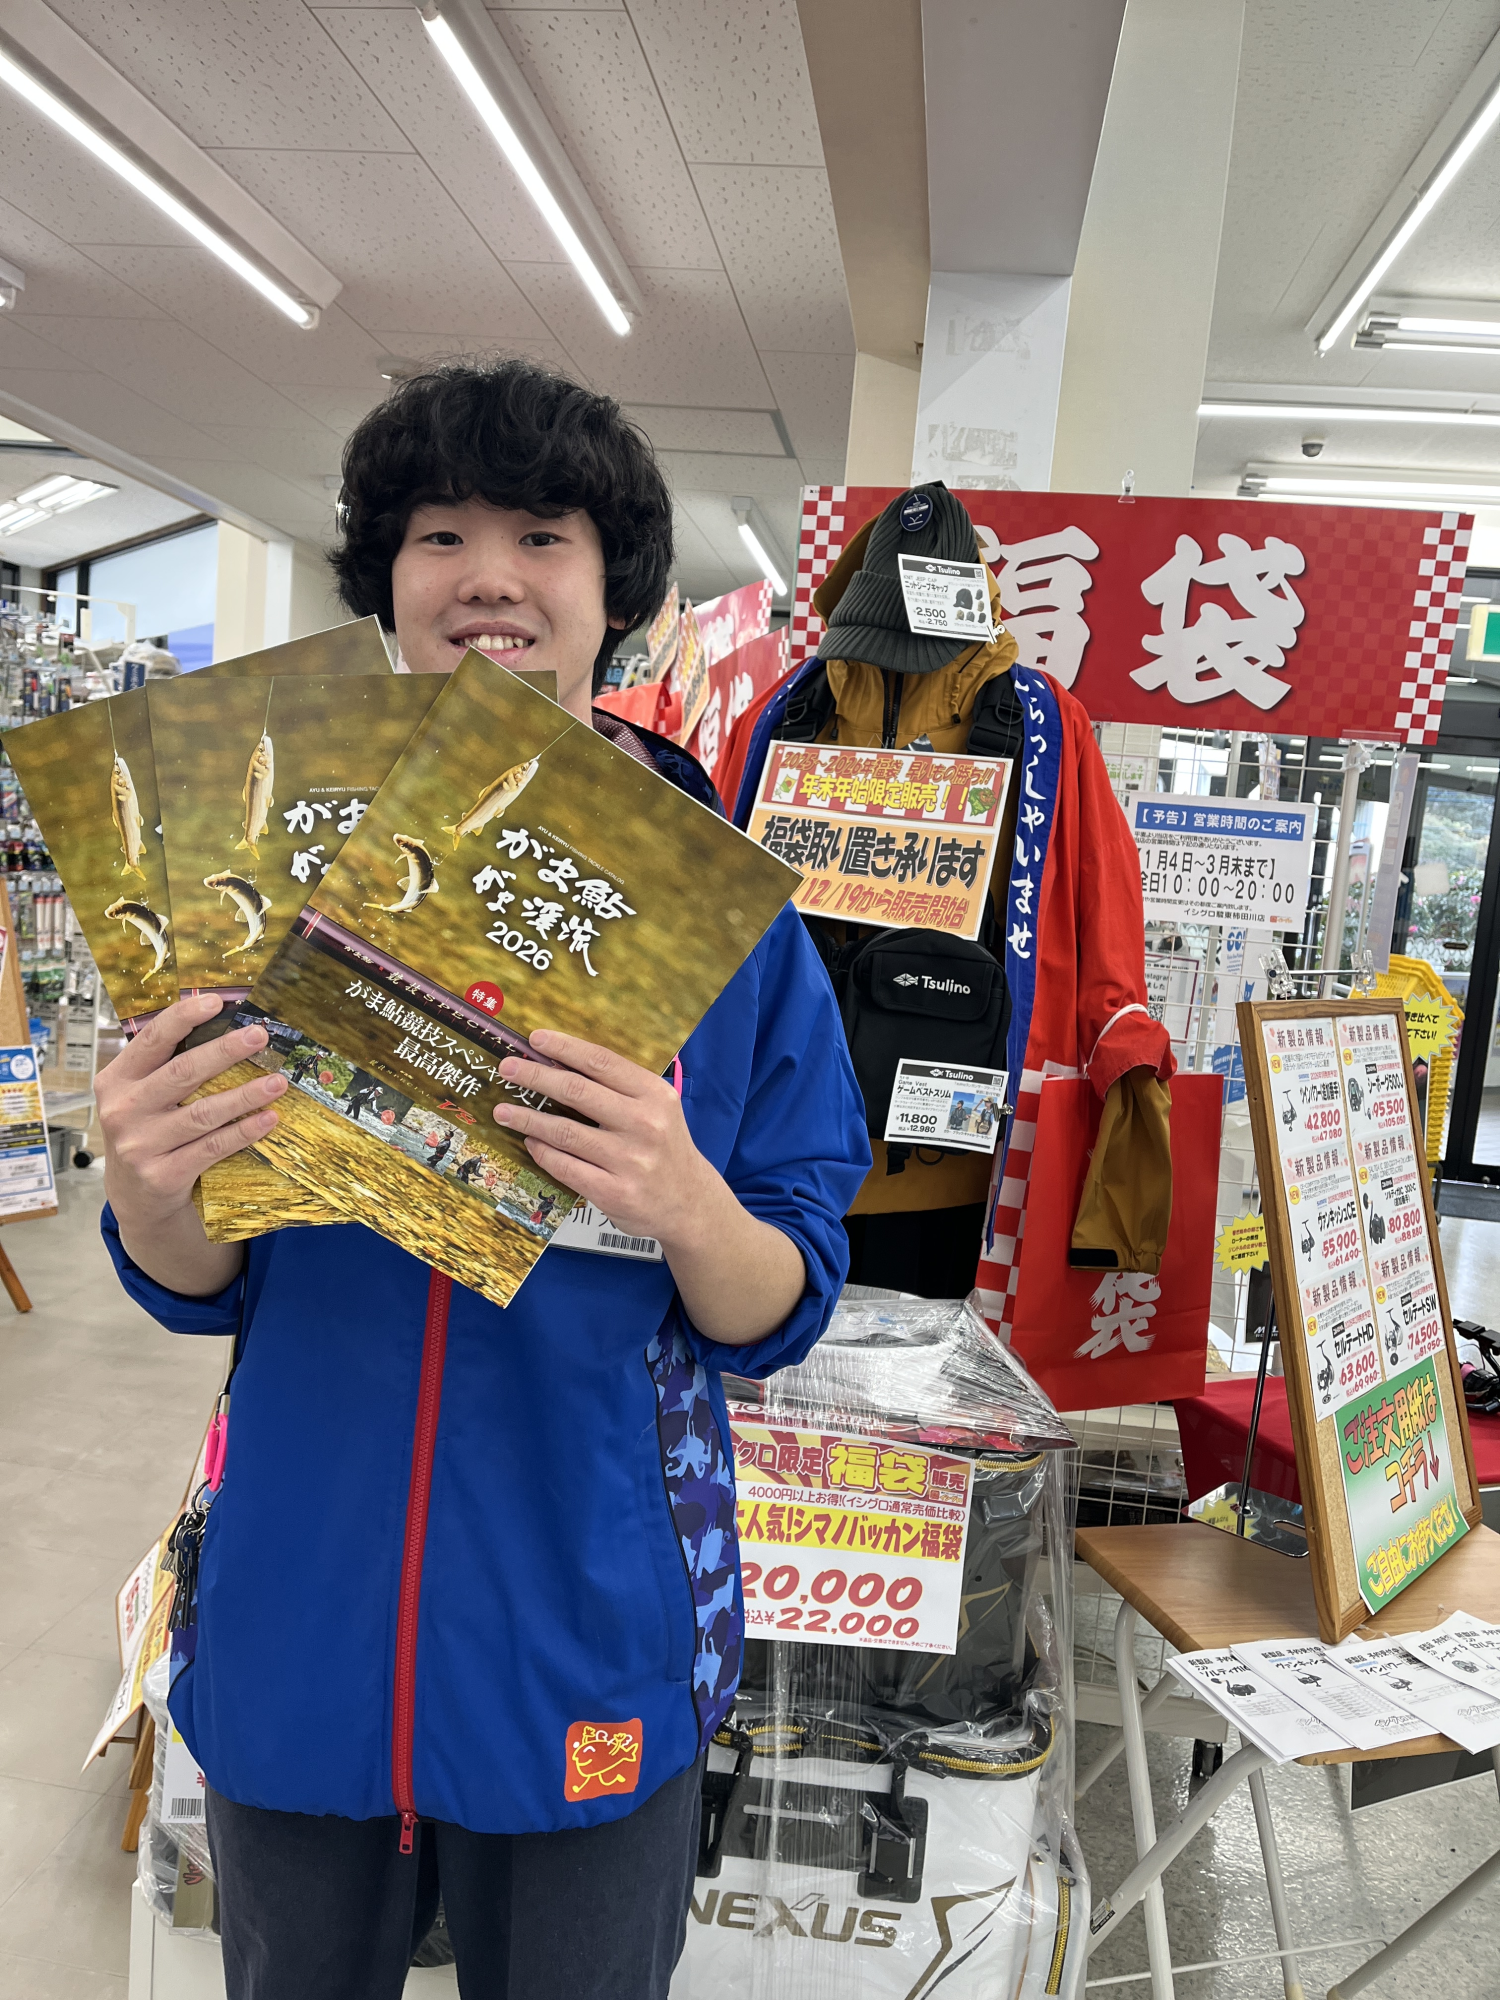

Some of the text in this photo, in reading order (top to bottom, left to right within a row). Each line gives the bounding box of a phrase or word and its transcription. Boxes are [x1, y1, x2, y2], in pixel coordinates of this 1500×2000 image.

[937, 566, 961, 576] Tsulino
[290, 844, 332, 884] が
[761, 815, 986, 890] 福袋取り置き承ります
[496, 828, 637, 920] がま鮎
[1184, 908, 1266, 922] イシグロ駿東柿田川店
[486, 921, 554, 971] 2026
[471, 988, 498, 1012] 特集
[921, 975, 971, 995] Tsulino
[1276, 1028, 1325, 1048] 新製品情報
[1348, 1024, 1388, 1042] 新製品情報
[394, 1036, 482, 1098] 最高傑作
[945, 1070, 974, 1081] Tsulino
[897, 1086, 952, 1099] ゲームベストスリム
[1294, 1148, 1340, 1178] 新製品情報
[1364, 1134, 1406, 1160] 新製品情報
[1381, 1246, 1422, 1278] 新製品情報
[1312, 1270, 1357, 1308] 新製品情報
[1402, 1294, 1437, 1326] セルテートSW
[1334, 1322, 1374, 1359] セルテートHD
[1344, 1373, 1437, 1475] ご注文用紙は
[732, 1441, 966, 1496] グロ限定 福袋 販売
[1385, 1437, 1429, 1514] コチラ
[748, 1486, 966, 1522] 4000円以上お得!(イシグロ通常売価比較)
[690, 1889, 902, 1949] NEXUS
